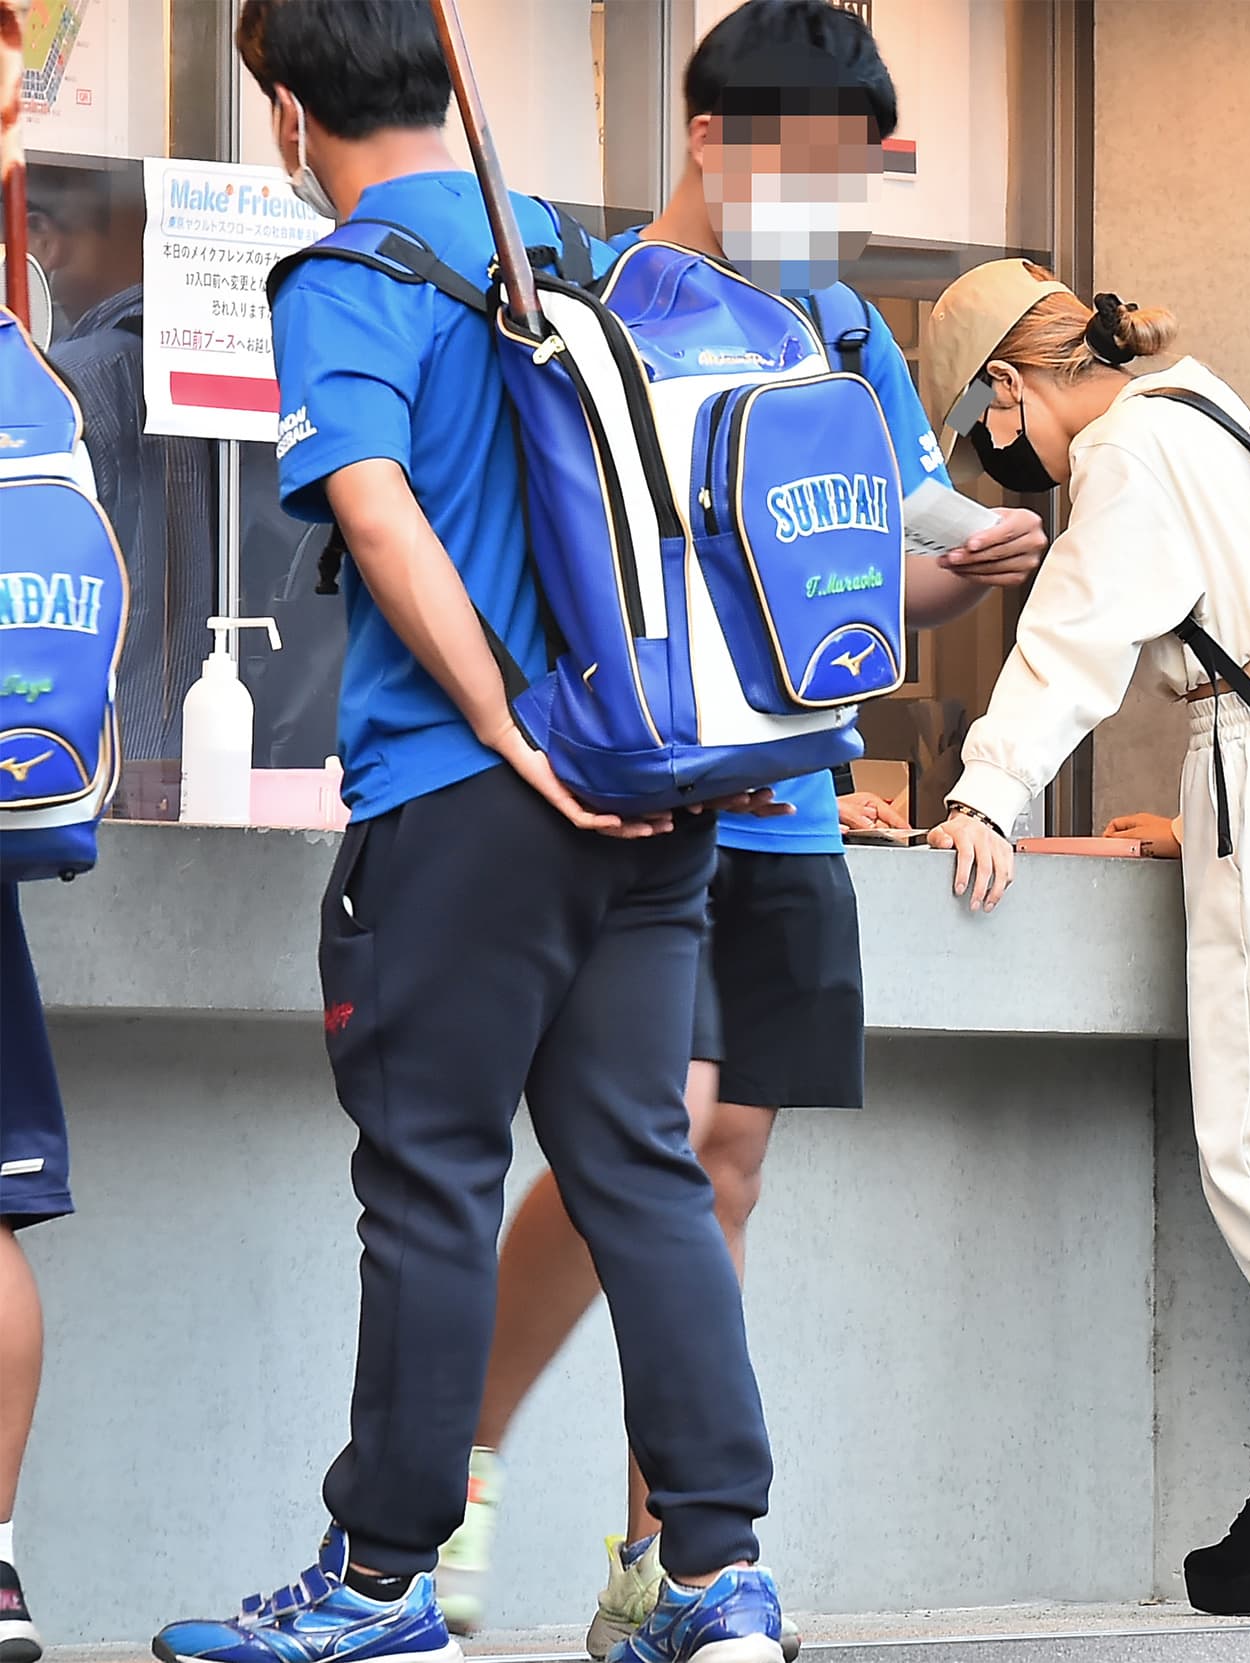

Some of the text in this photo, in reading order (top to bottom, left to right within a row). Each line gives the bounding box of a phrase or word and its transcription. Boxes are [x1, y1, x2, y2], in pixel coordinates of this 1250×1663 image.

[170, 178, 230, 213] Make
[211, 299, 271, 320] 恐れ入ります
[767, 473, 889, 543] SUNDAI
[0, 572, 104, 635] NDAI
